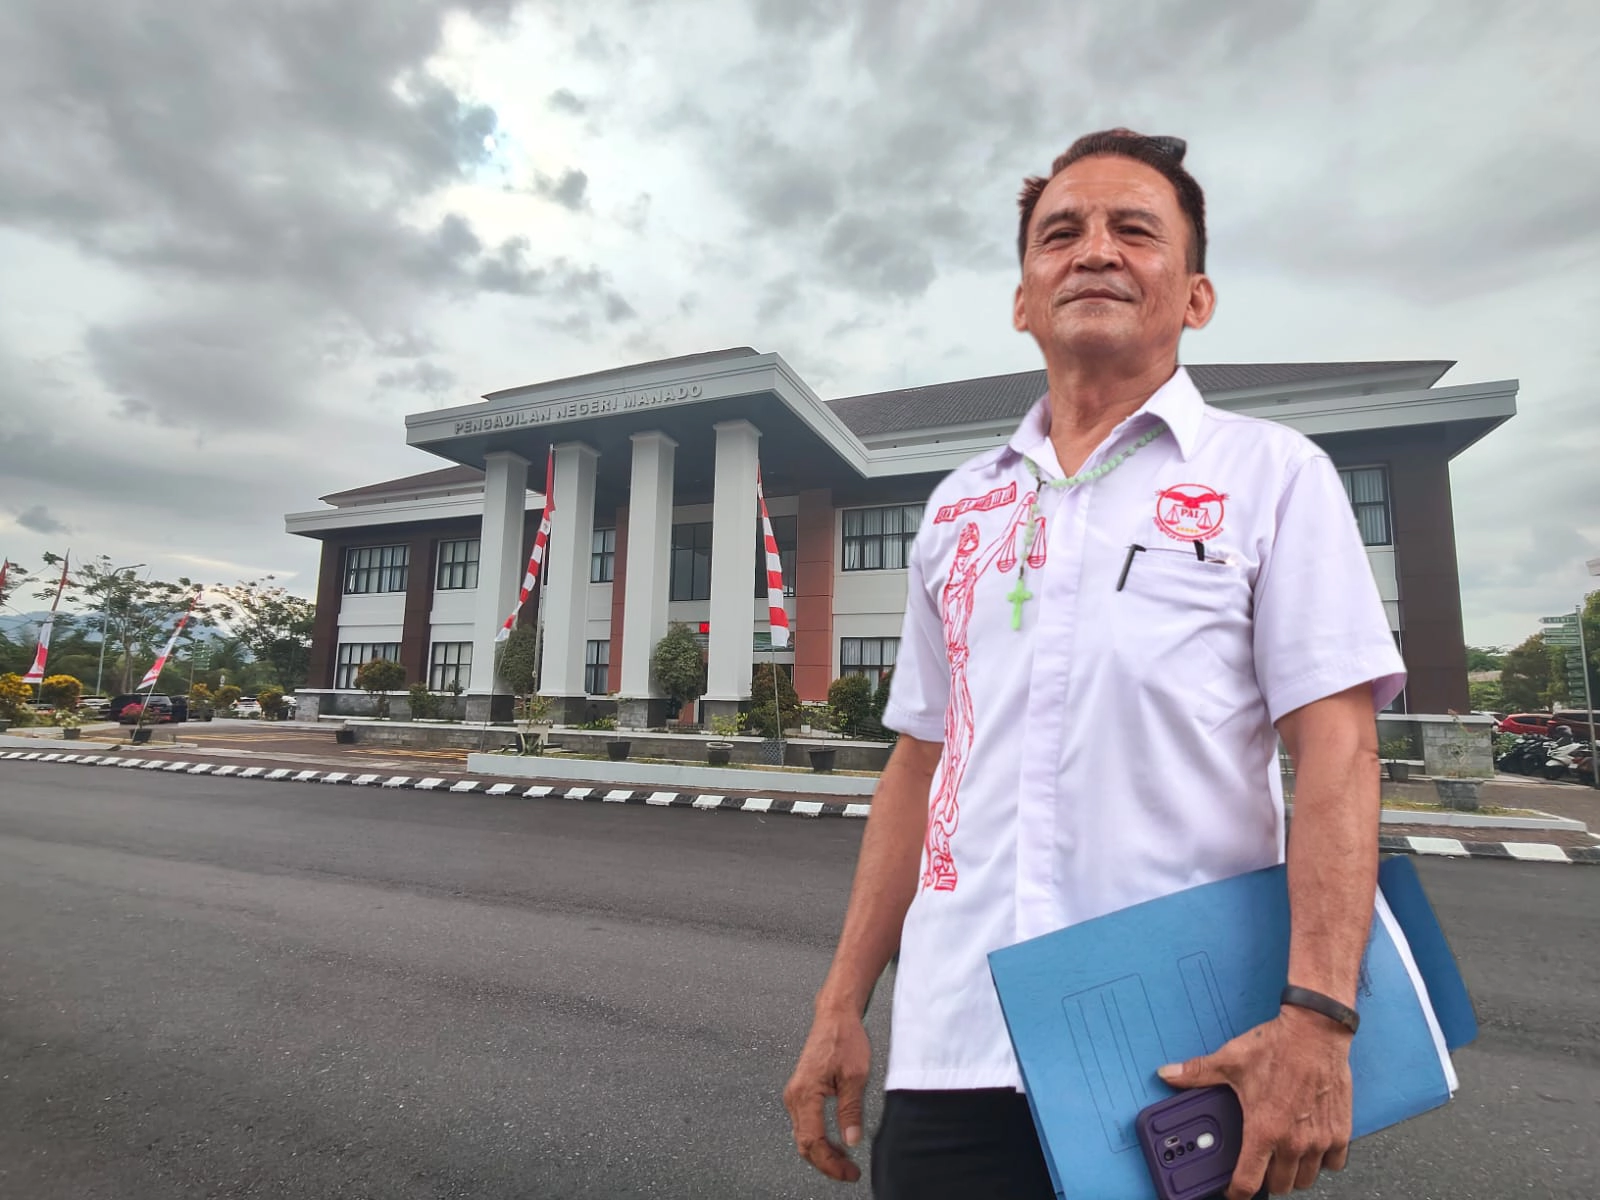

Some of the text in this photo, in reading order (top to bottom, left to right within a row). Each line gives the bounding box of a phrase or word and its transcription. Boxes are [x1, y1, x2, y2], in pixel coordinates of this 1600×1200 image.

[454, 383, 703, 434] PENGADILAN NEGERI MANADO
